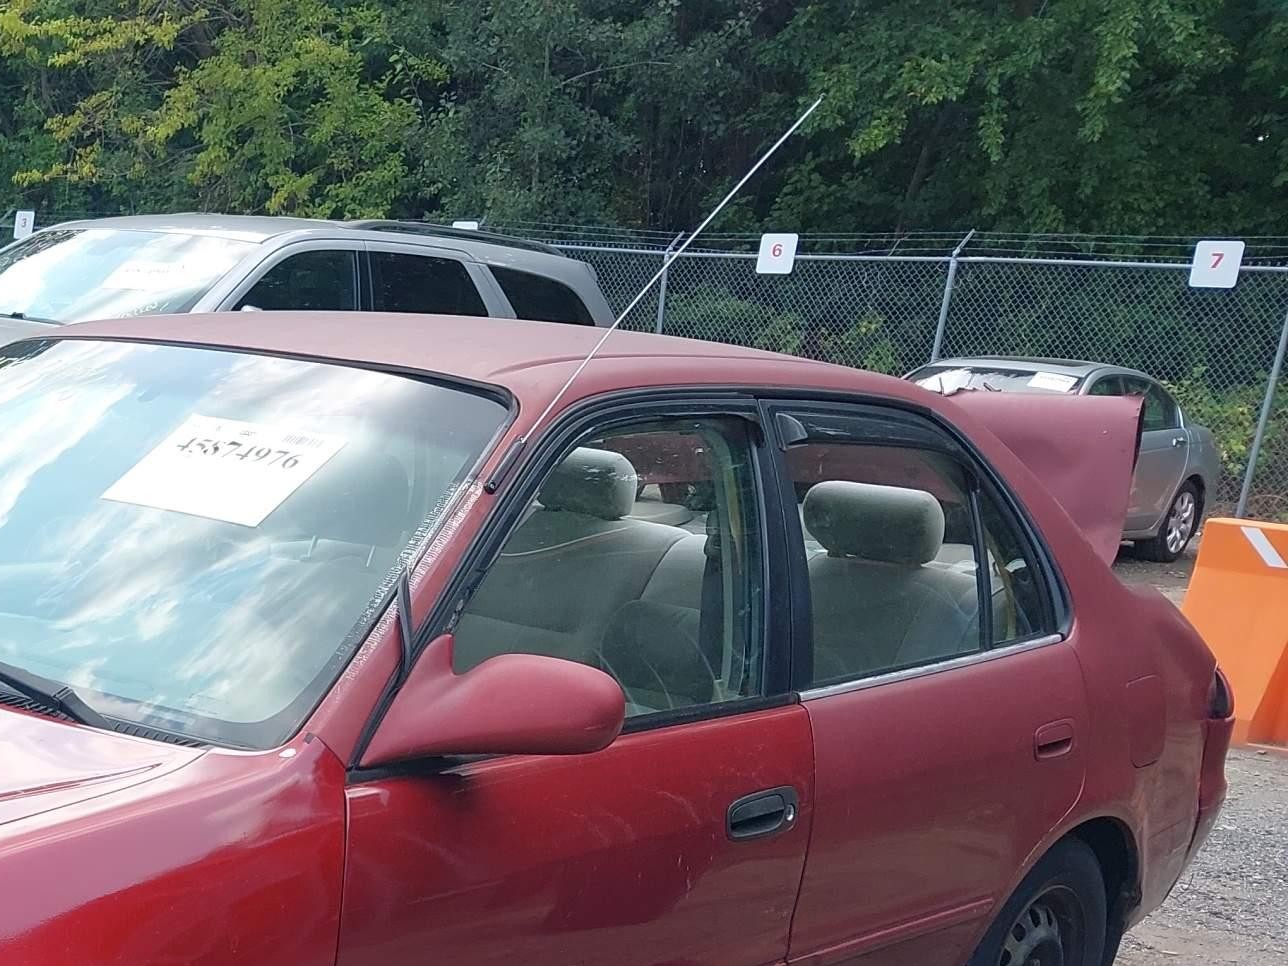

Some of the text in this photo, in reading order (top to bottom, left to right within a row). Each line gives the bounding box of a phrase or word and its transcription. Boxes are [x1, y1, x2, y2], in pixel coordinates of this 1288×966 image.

[21, 217, 28, 228] 3
[772, 243, 783, 258] 6
[1211, 252, 1225, 269] 7
[176, 437, 302, 469] 45874976
